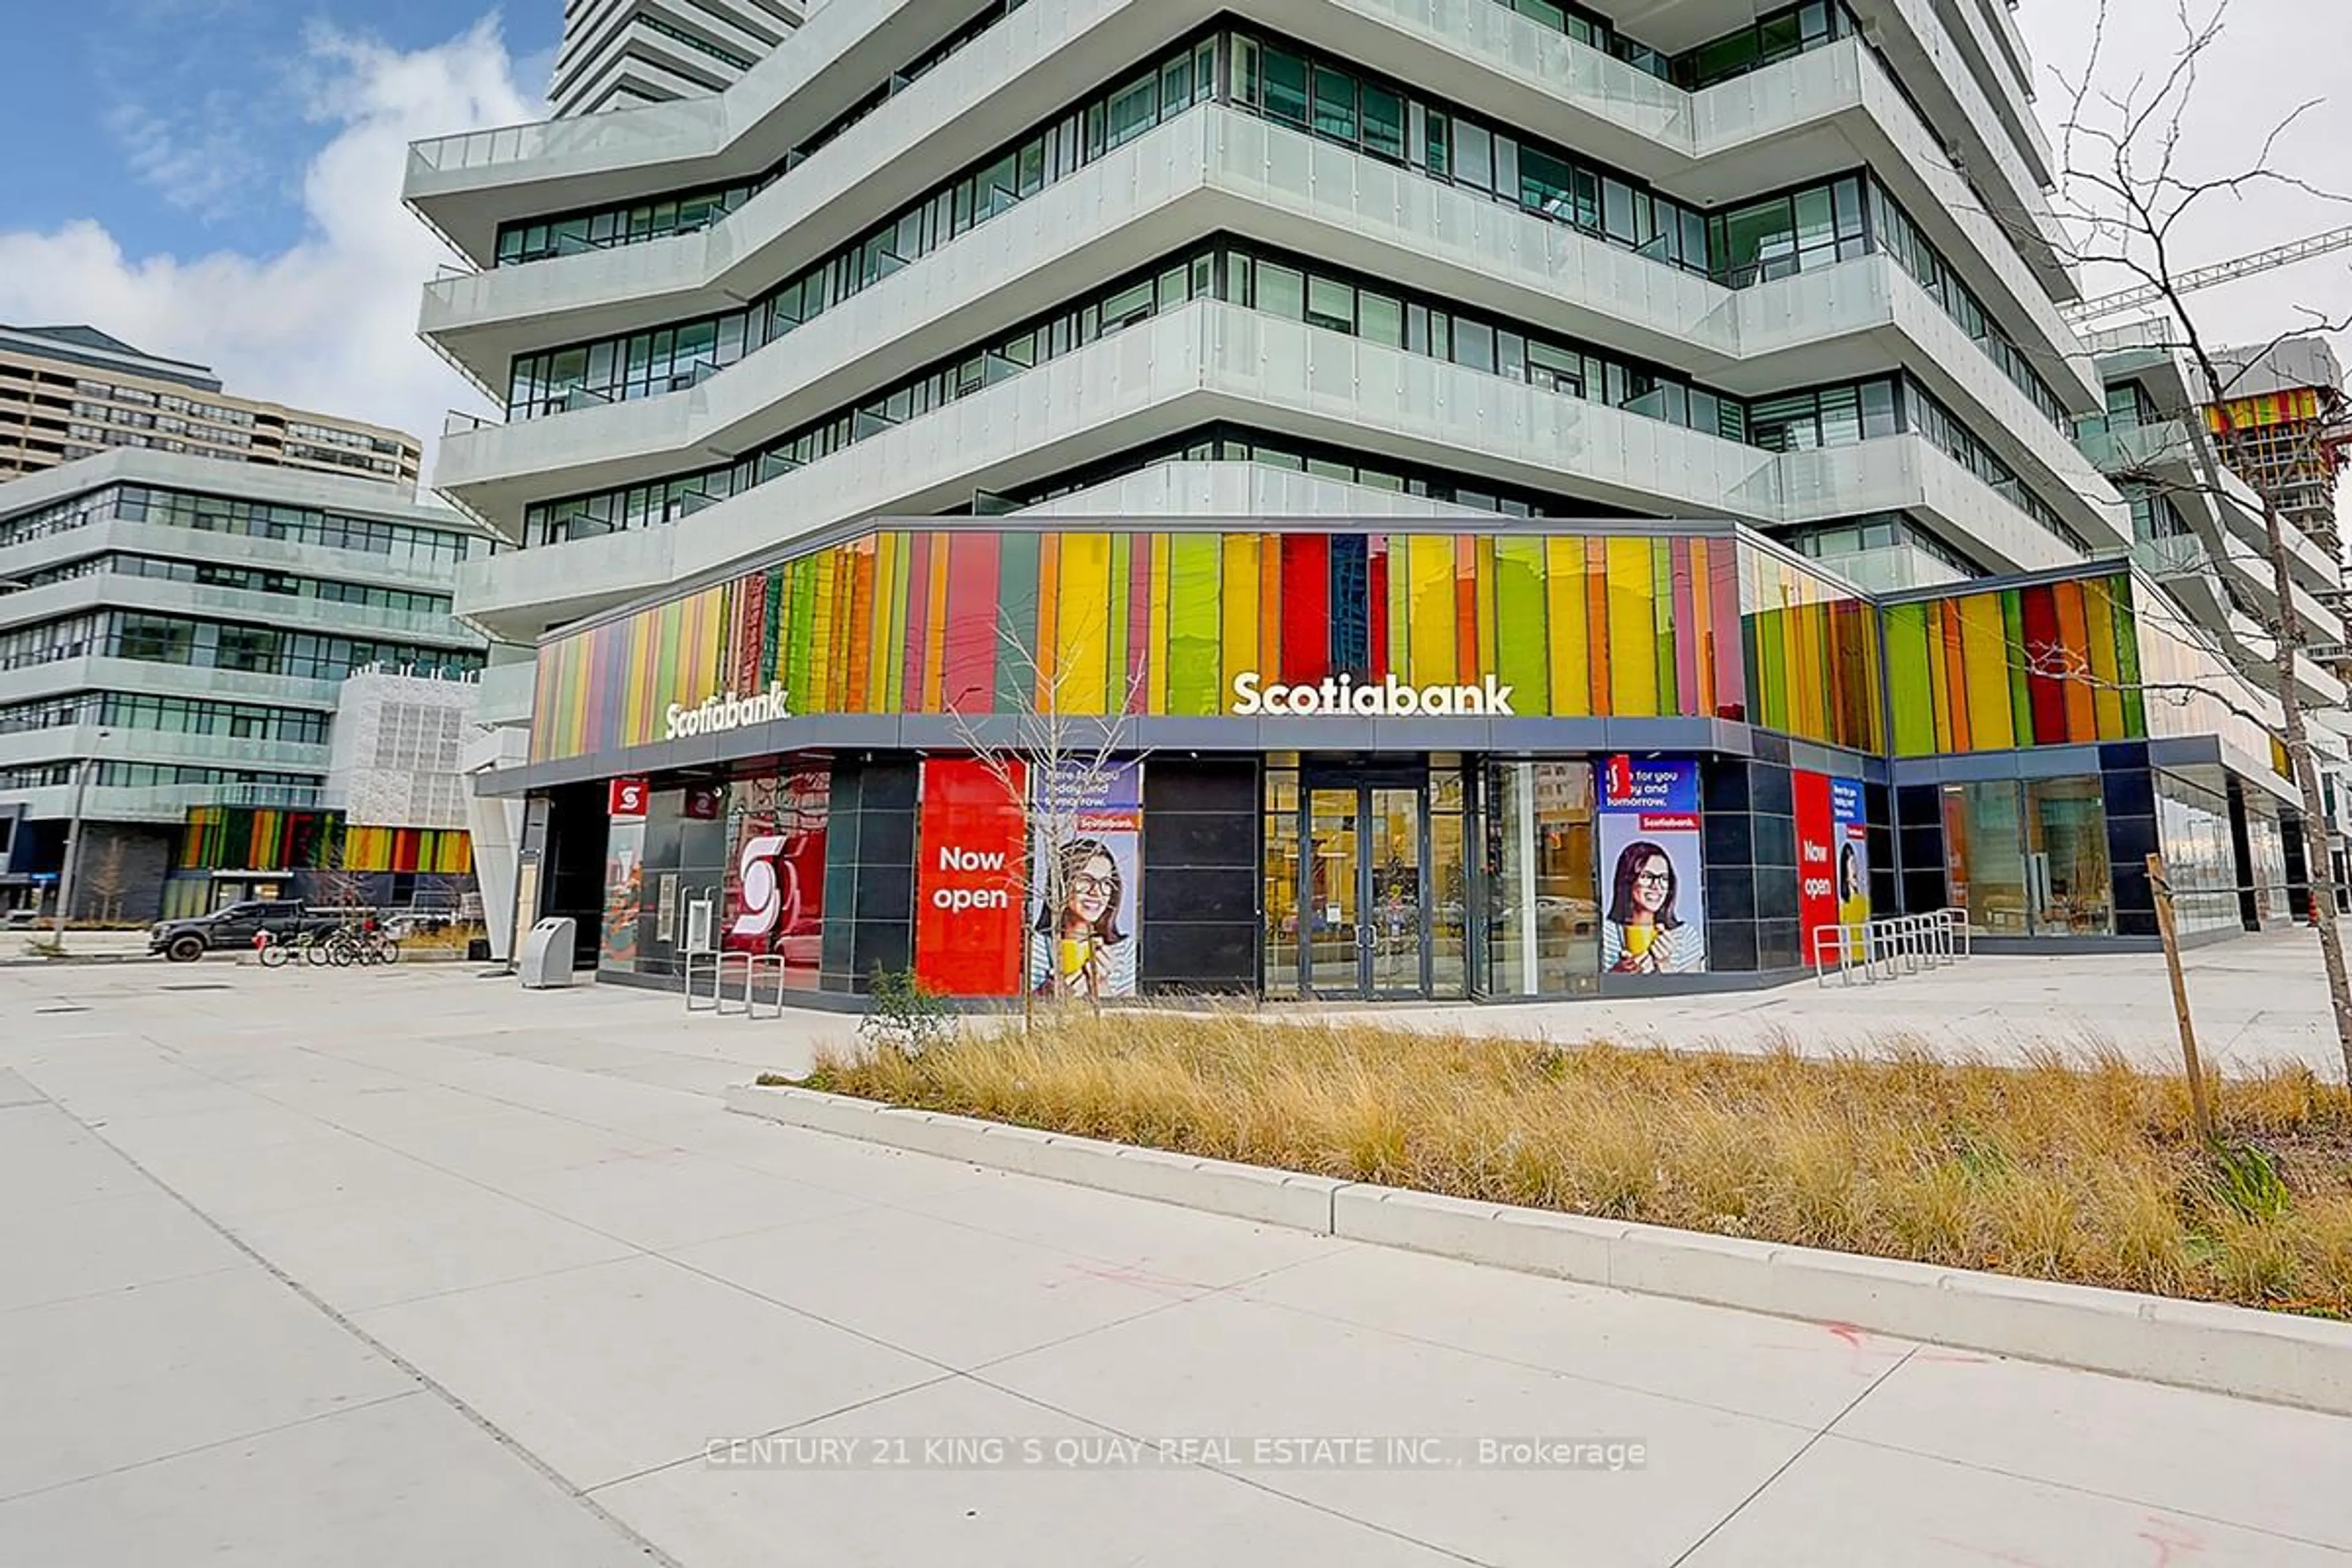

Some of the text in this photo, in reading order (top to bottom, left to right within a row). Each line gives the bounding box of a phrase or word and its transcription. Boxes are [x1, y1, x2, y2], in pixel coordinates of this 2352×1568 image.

[1232, 672, 1513, 716] Scotiabank
[665, 680, 791, 740] Scotiabank
[1636, 771, 1653, 782] for
[1654, 772, 1679, 783] you
[1045, 783, 1081, 796] tday
[1644, 783, 1668, 794] and
[1044, 797, 1106, 807] tmorow.
[940, 846, 1005, 871] Now
[1803, 840, 1828, 862] Now
[1804, 878, 1832, 900] open
[932, 888, 1008, 914] open
